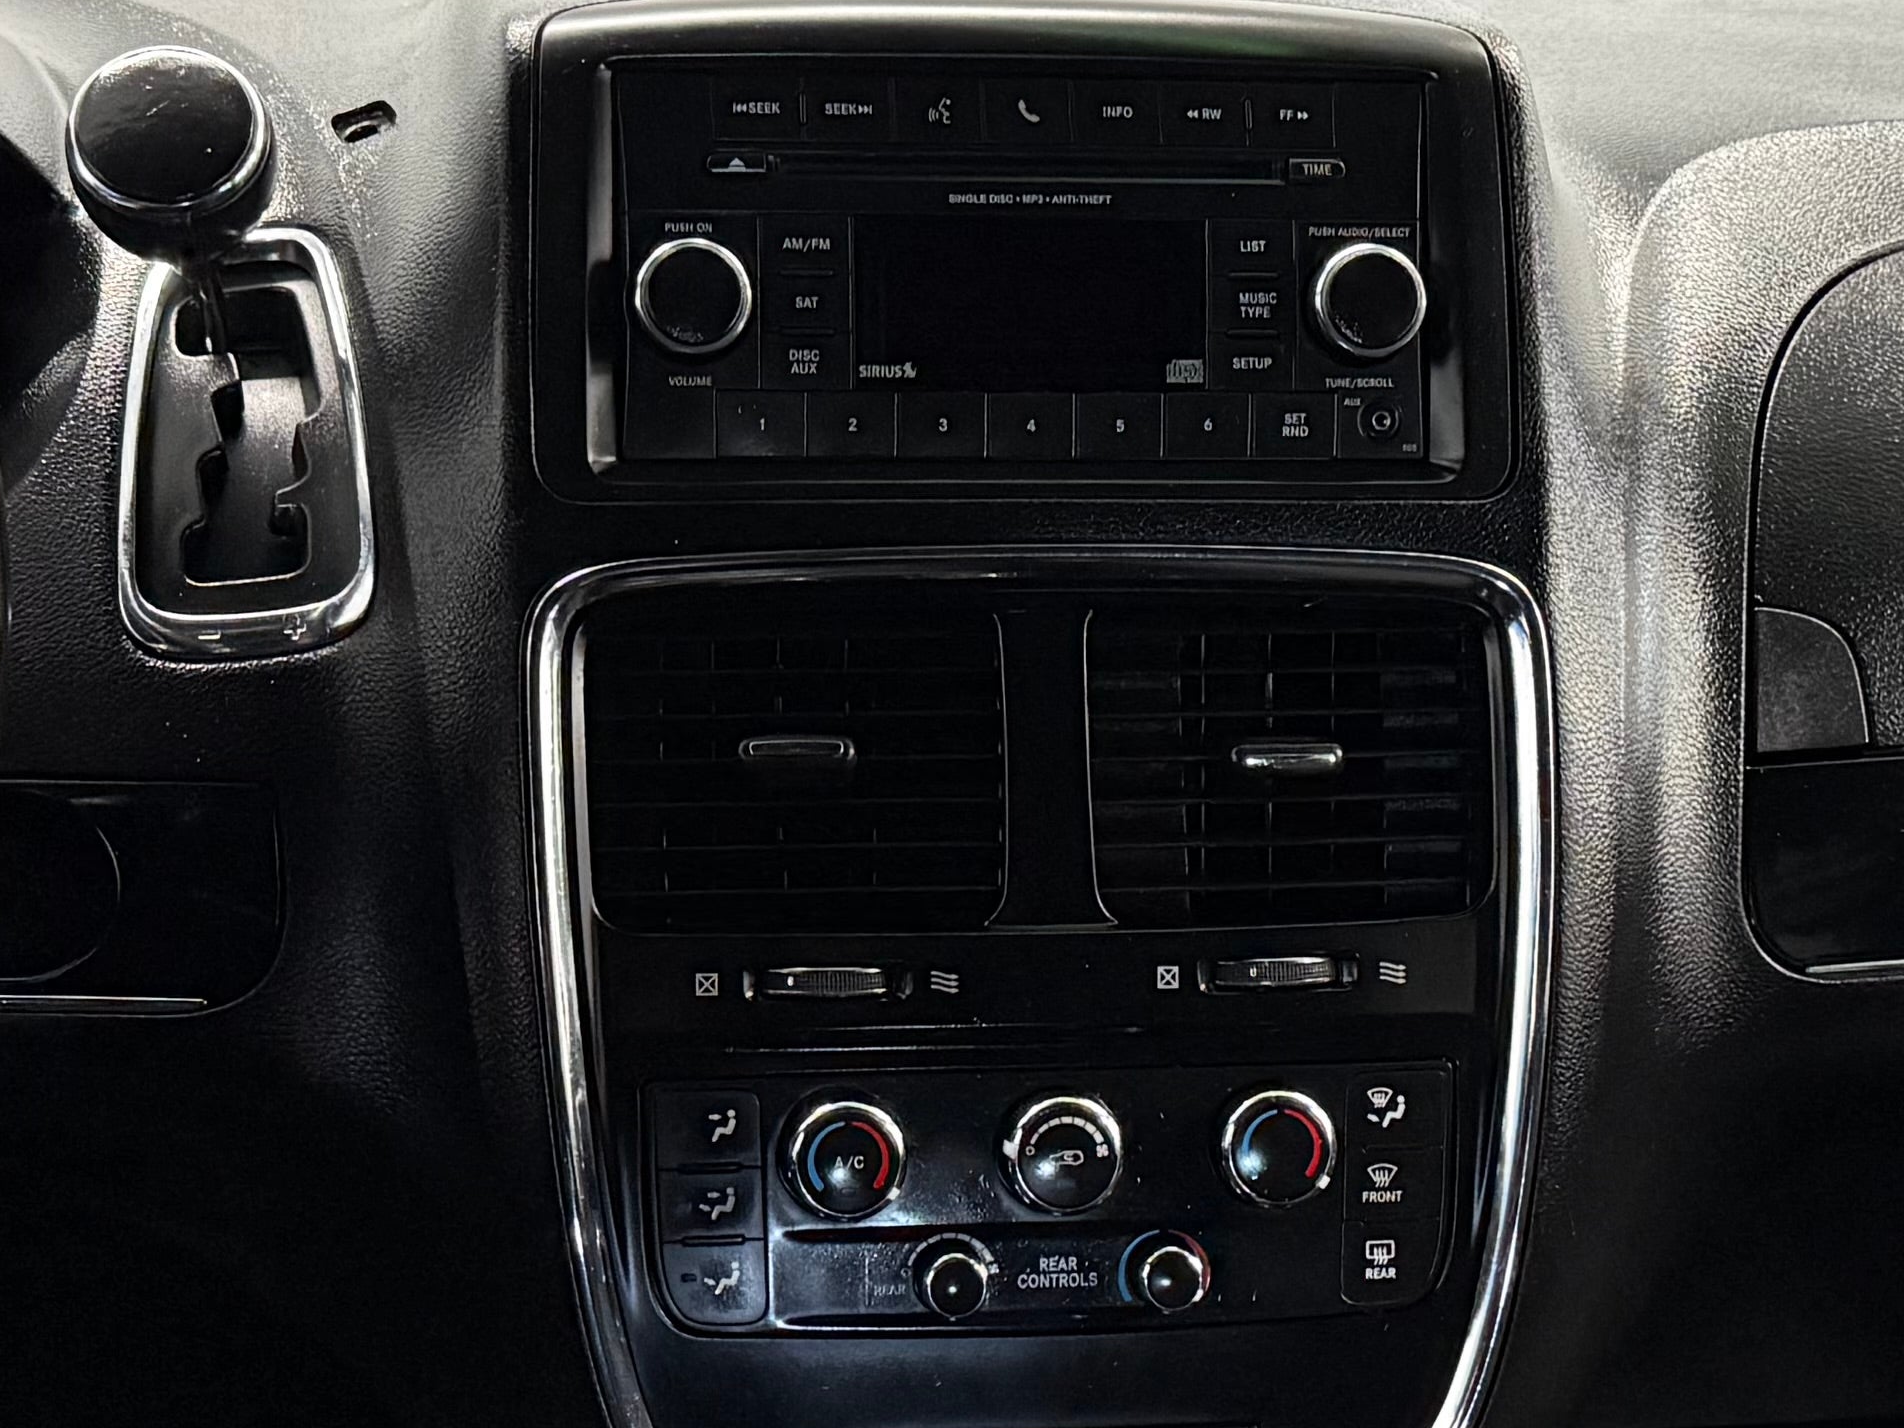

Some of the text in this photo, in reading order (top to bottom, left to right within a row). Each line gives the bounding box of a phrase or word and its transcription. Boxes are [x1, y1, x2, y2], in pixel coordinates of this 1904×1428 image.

[748, 101, 781, 114] SEEK
[824, 103, 857, 115] SEEK
[1102, 105, 1133, 118] INFO
[1201, 108, 1222, 120] RW
[1279, 109, 1294, 121] FF
[1302, 163, 1332, 176] TIME
[948, 193, 987, 204] SINGLE
[989, 193, 1014, 204] DISC
[664, 222, 713, 233] PUSH ON
[1308, 226, 1336, 237] PUSH
[782, 237, 831, 252] AM/FM
[1239, 240, 1267, 253] LIST
[794, 296, 819, 309] SAT
[1239, 292, 1278, 305] MUSIC
[1240, 306, 1271, 318] TYPE
[788, 348, 820, 362] DISC
[790, 362, 818, 375] AUX
[1232, 357, 1273, 370] SETUP
[859, 364, 902, 378] SIRIUS
[668, 375, 713, 387] VOLUME
[1324, 377, 1395, 389] TUNE/SCROLL
[759, 418, 765, 431] 1
[847, 418, 858, 431] 2
[938, 418, 948, 432] 3
[1203, 418, 1213, 431] 6
[1284, 412, 1307, 425] SET
[1026, 419, 1036, 432] 4
[1116, 419, 1125, 432] 5
[1281, 425, 1309, 438] RND
[834, 1155, 865, 1170] A/C
[1361, 1190, 1404, 1203] FRONT
[1039, 1256, 1078, 1272] REAR
[1365, 1267, 1397, 1280] REAR
[1017, 1272, 1098, 1289] CONTROLS
